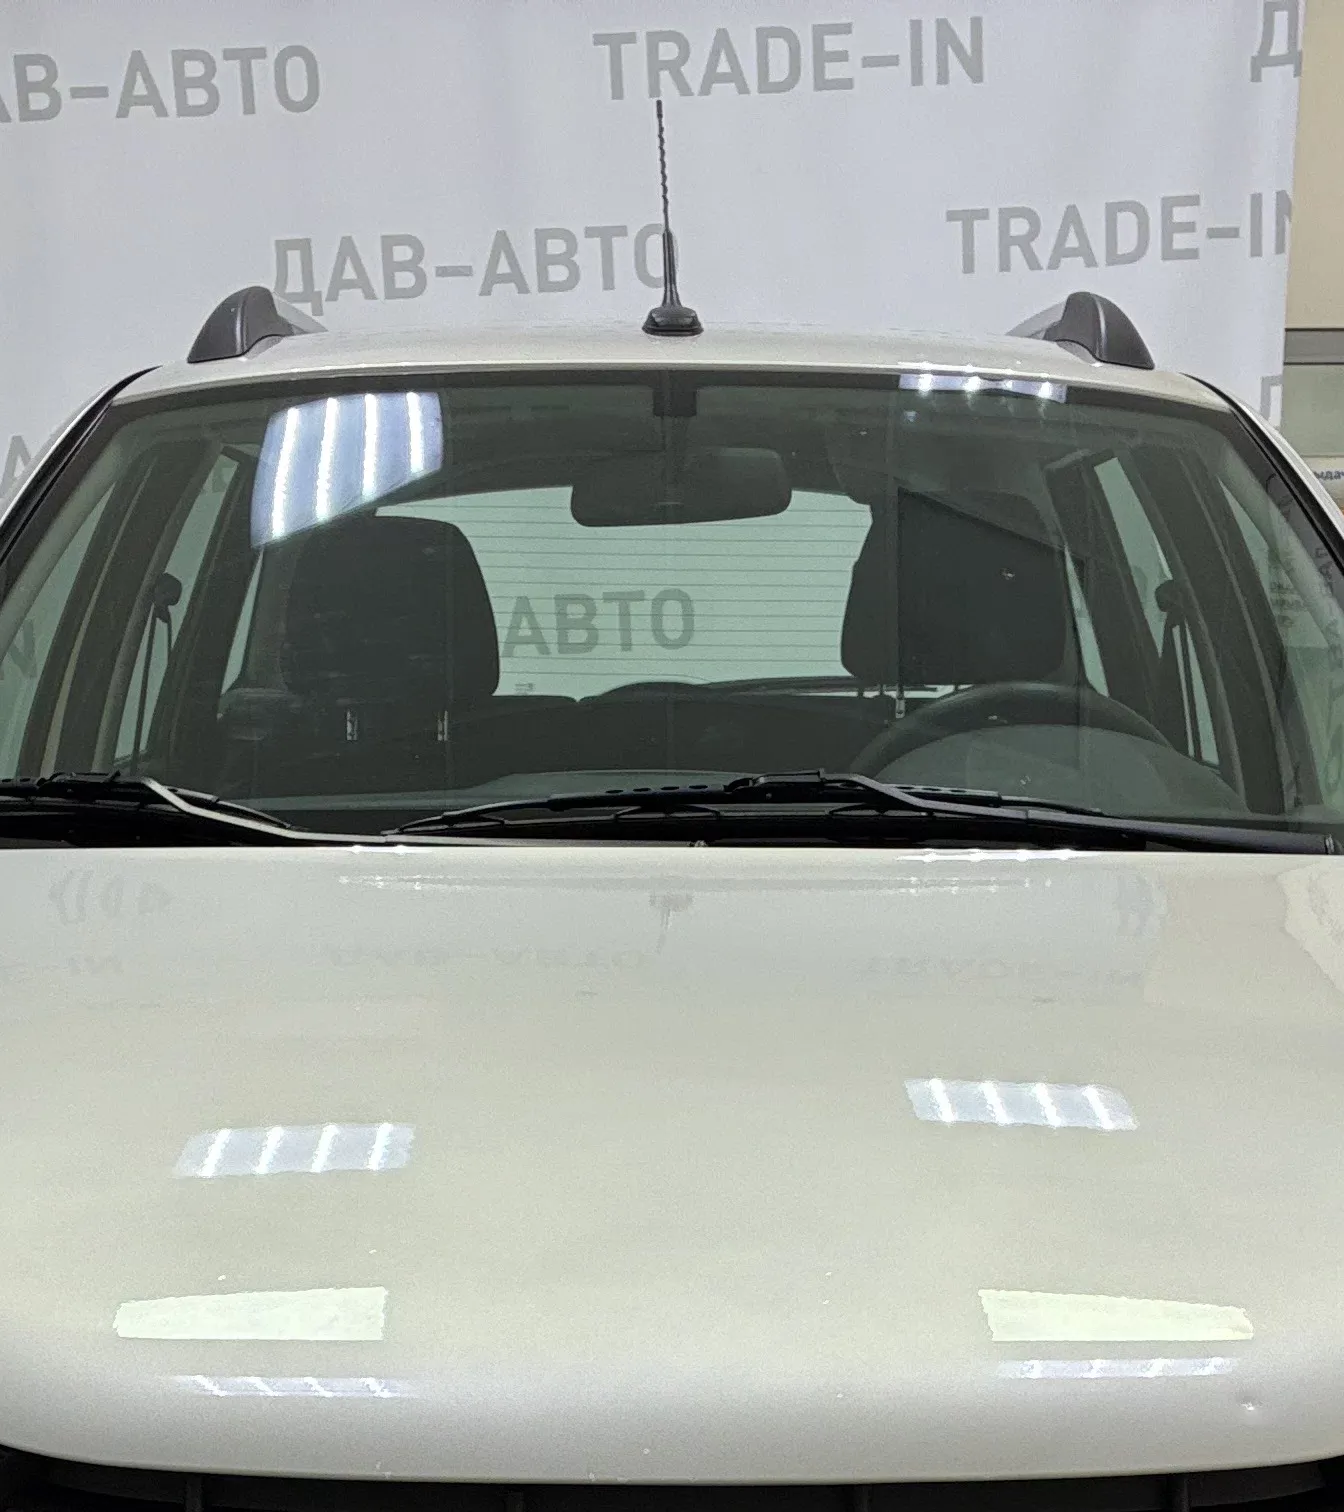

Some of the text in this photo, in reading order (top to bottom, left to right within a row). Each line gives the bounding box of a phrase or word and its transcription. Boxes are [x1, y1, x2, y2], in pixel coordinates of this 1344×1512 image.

[593, 16, 985, 100] TRADE-IN
[273, 224, 679, 317] ДАВ-АВТО
[502, 588, 695, 658] АВТО
